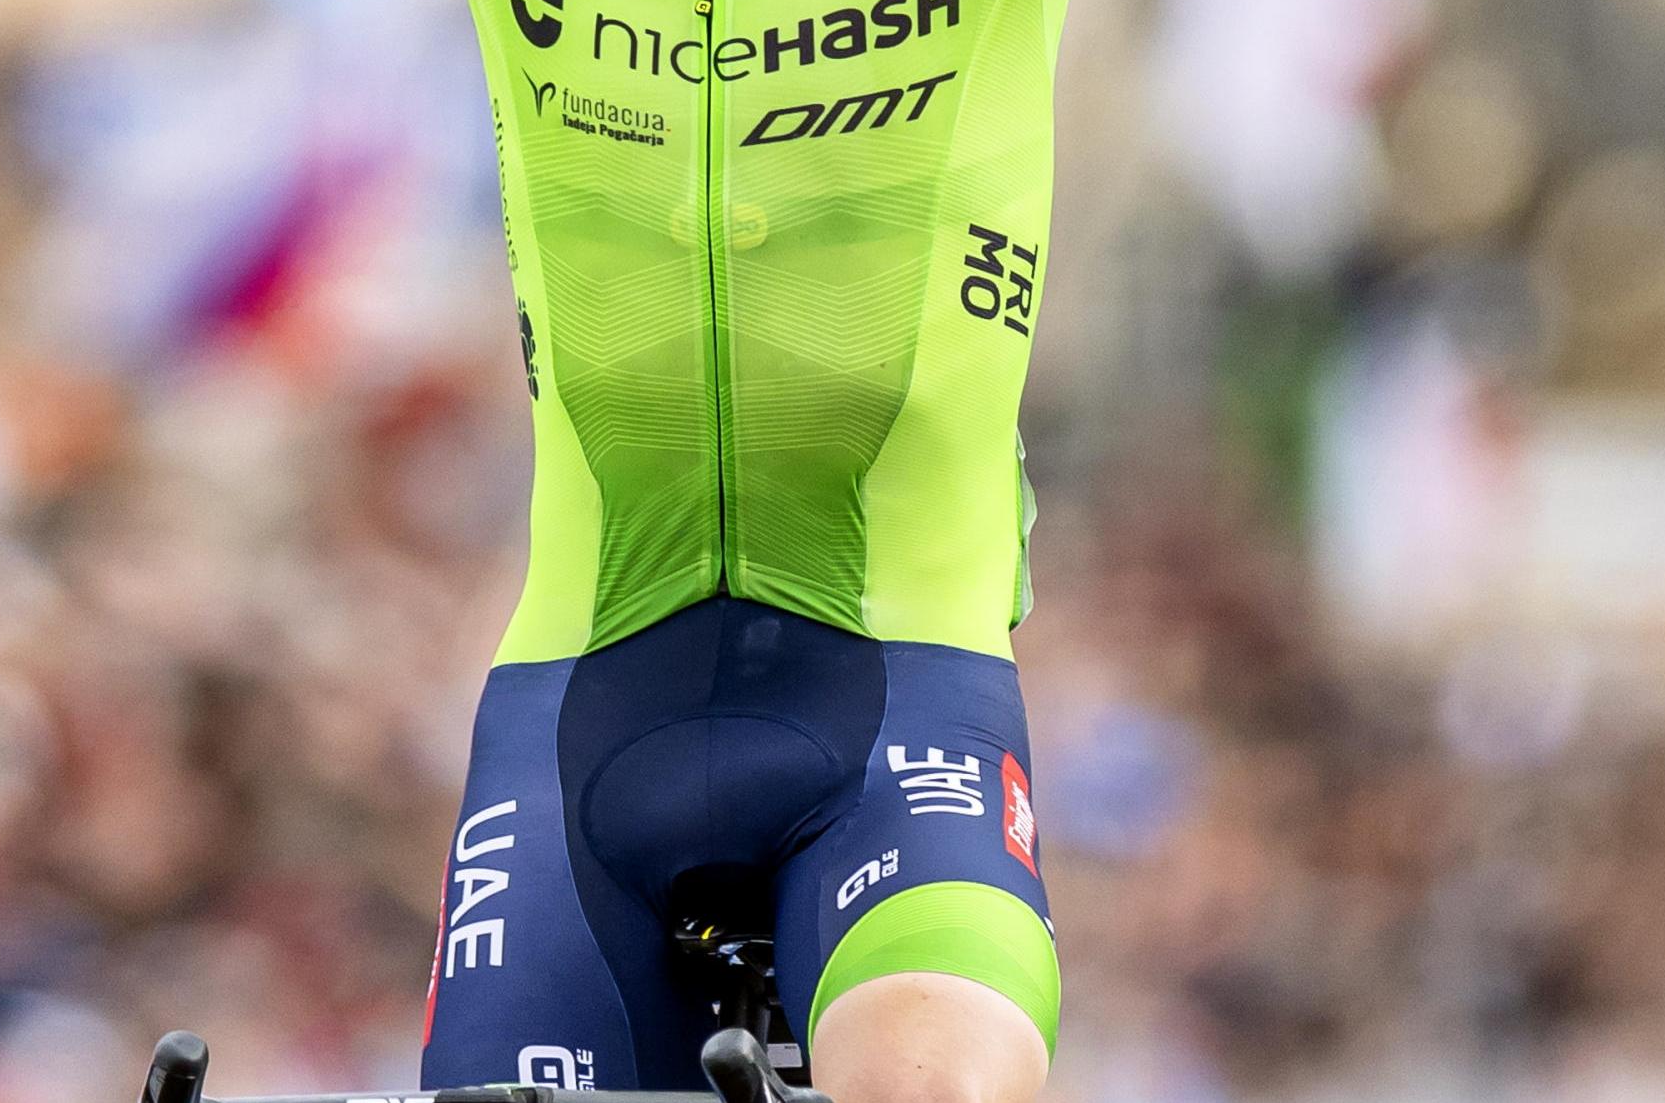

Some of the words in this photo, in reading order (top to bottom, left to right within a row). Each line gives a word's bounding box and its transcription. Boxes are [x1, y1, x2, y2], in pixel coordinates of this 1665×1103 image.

[739, 70, 958, 148] DMT
[960, 223, 1008, 320] MO
[1003, 243, 1038, 338] TRI
[887, 745, 985, 817] UAE
[445, 799, 517, 979] UAE
